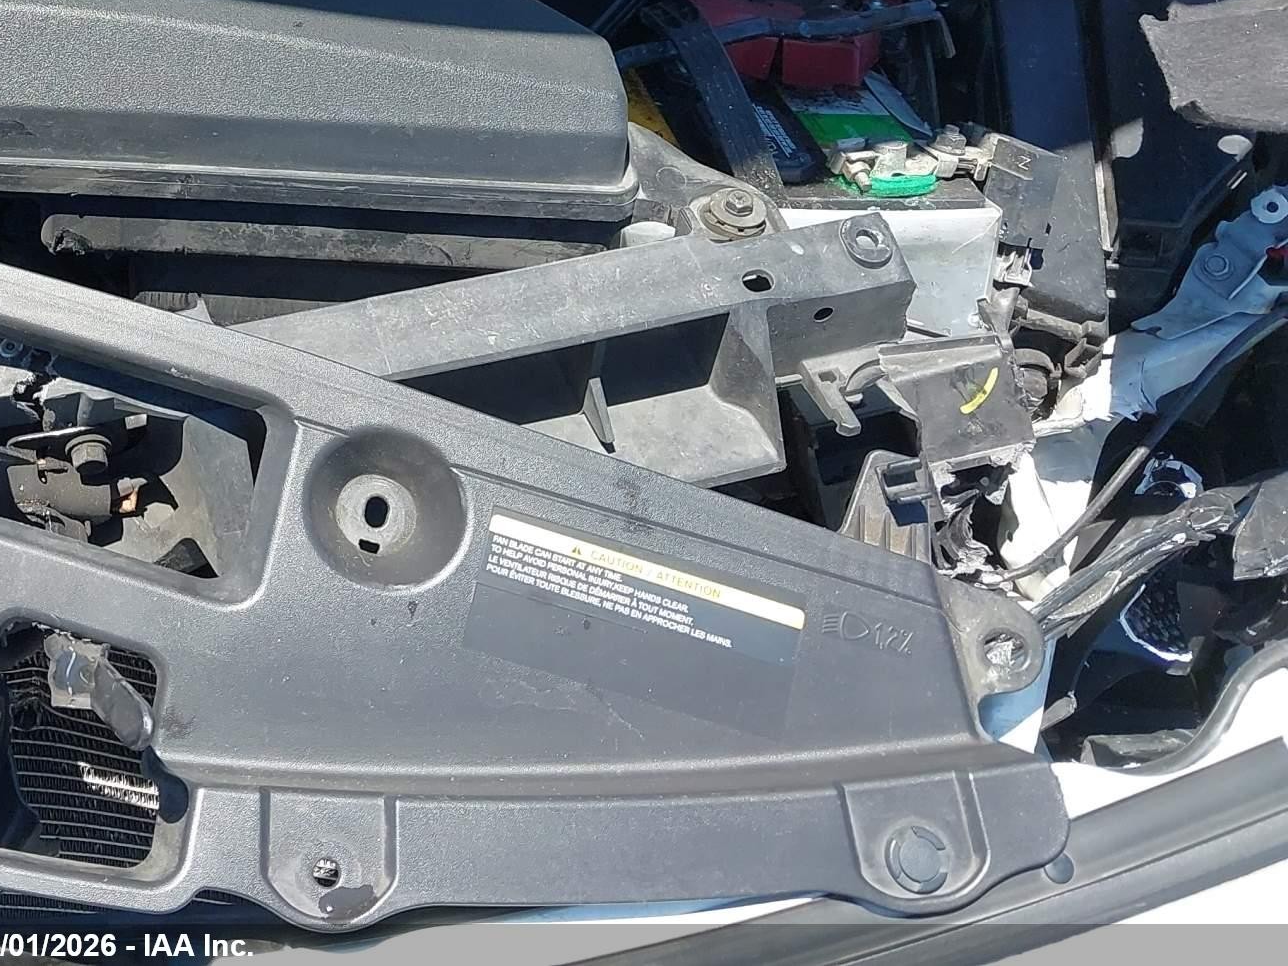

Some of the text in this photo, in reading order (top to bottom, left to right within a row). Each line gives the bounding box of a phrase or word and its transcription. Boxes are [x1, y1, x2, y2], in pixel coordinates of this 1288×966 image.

[487, 554, 499, 563] LE
[498, 557, 547, 579] VENTILATEUR
[547, 572, 576, 588] RISQUE
[576, 582, 588, 592] DE
[637, 601, 658, 614] TOUT
[489, 543, 502, 554] TO
[501, 547, 523, 560] HELP
[522, 553, 546, 567] AVOID
[546, 561, 588, 580] PERSONAL
[633, 588, 662, 604] HANDS
[661, 597, 690, 612] CLEAR.
[492, 534, 624, 582] FAN BLADE CAN START AT ANY TIME.
[590, 550, 643, 573] CAUTION
[655, 570, 721, 599] ATTENTION
[485, 563, 509, 576] POUR
[534, 578, 561, 593] TOUTE
[602, 600, 614, 610] NE
[613, 604, 630, 615] PAS
[630, 609, 642, 619] EN
[642, 612, 690, 634] APPROCHER
[690, 628, 706, 639] LES
